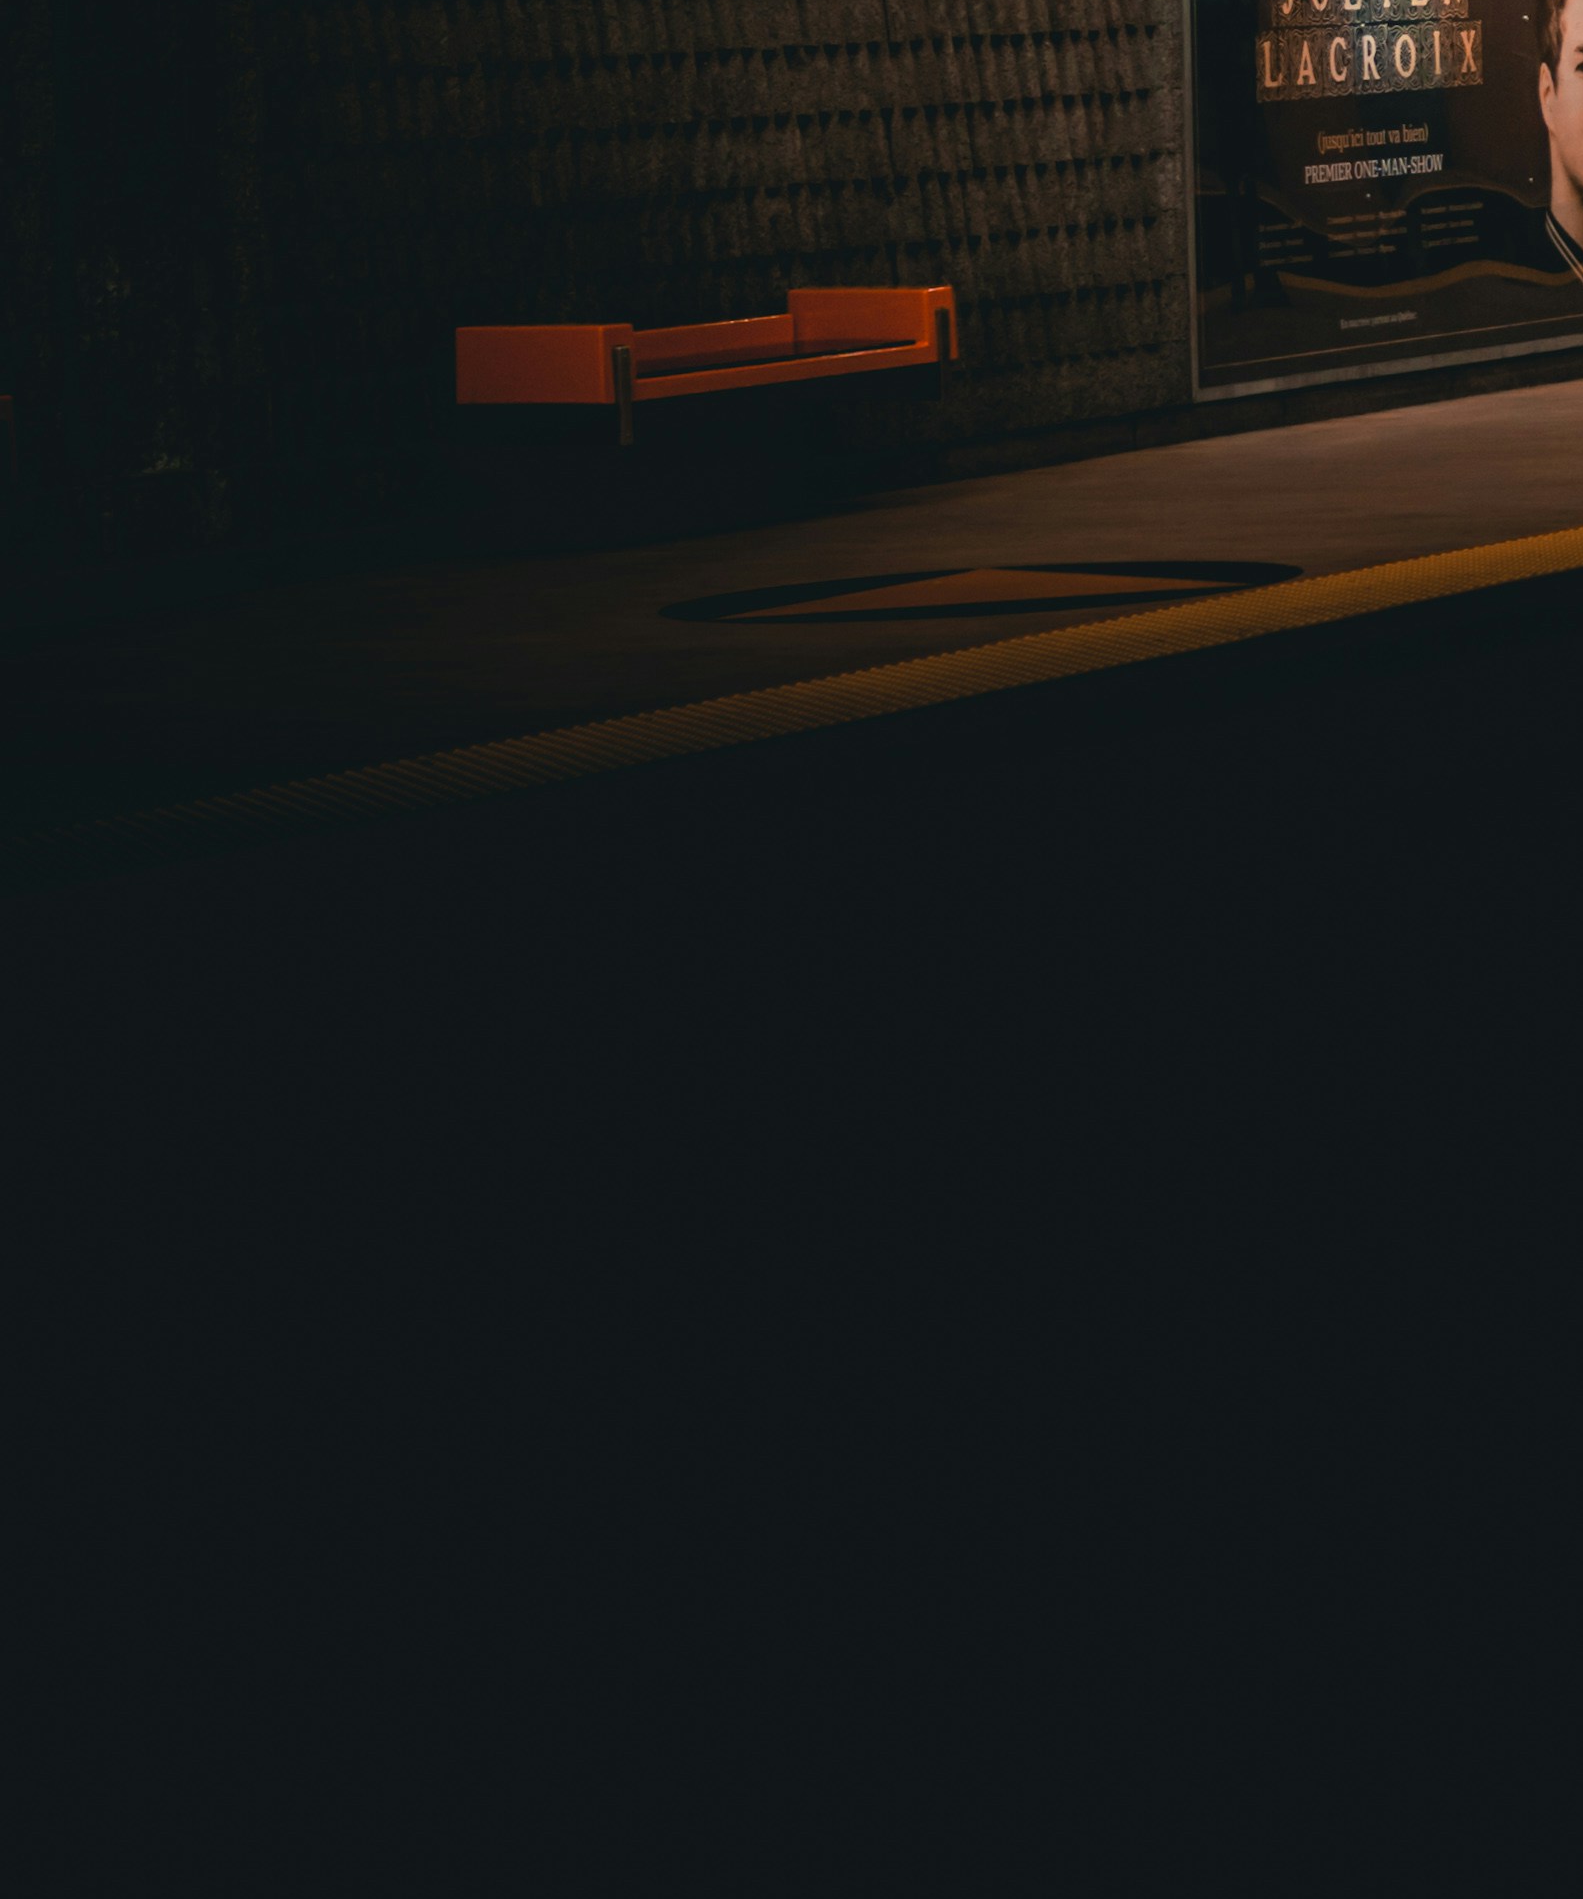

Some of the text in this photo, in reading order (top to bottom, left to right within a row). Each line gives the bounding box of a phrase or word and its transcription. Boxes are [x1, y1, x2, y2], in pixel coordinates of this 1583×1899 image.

[1262, 30, 1477, 88] LACROIX
[1366, 129, 1386, 145] tout
[1388, 130, 1401, 144] va
[1304, 153, 1443, 185] PREMIER ONE-MAN-SHOW
